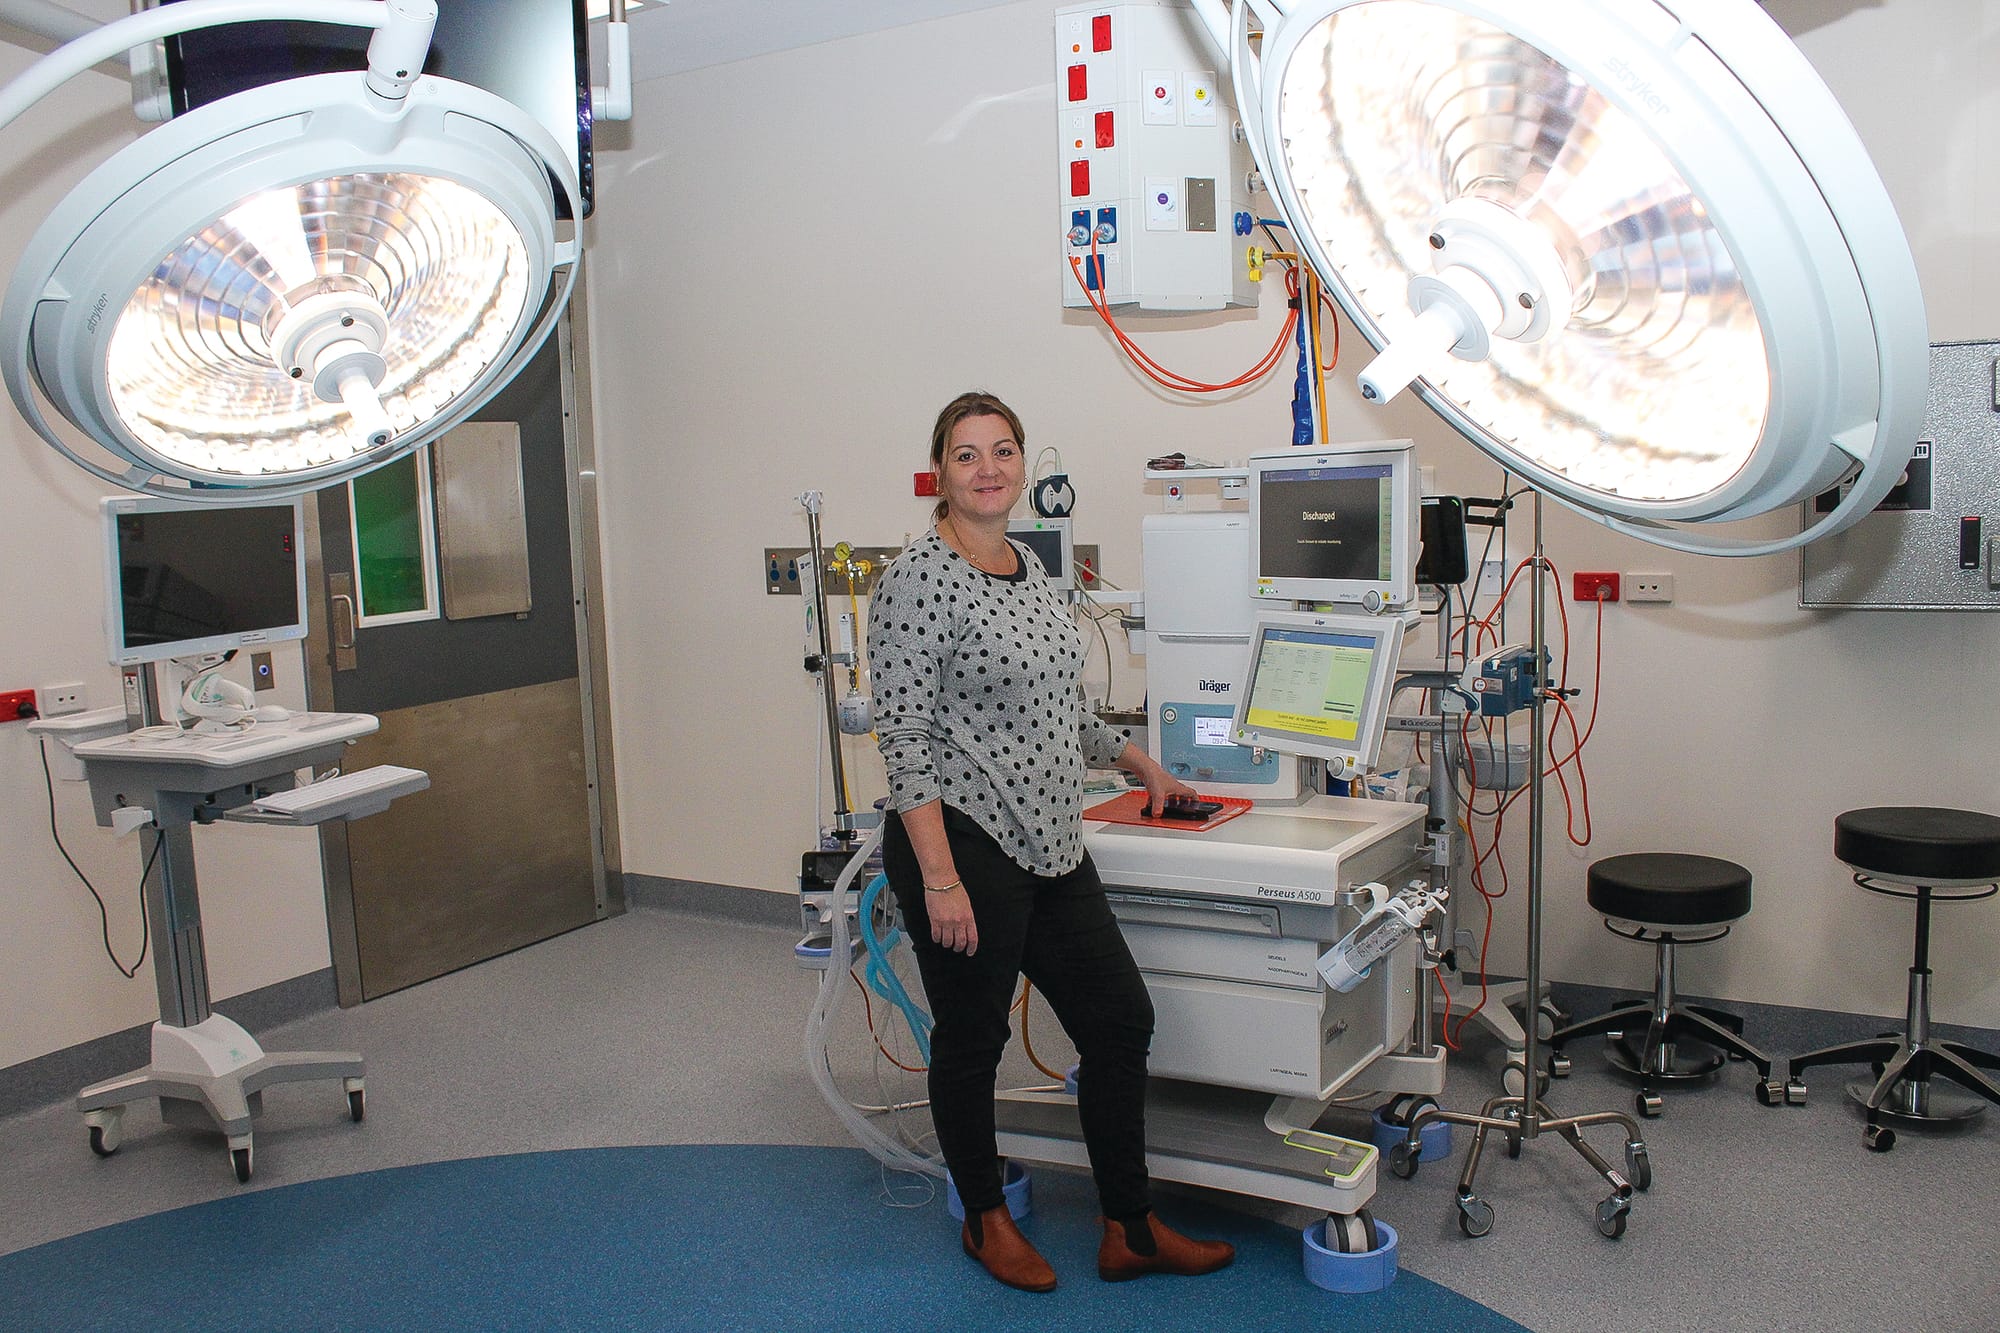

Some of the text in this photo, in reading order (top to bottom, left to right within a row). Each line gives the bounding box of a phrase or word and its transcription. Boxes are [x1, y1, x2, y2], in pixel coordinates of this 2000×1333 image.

[1603, 57, 1671, 115] stryker
[87, 292, 109, 335] stryker
[1302, 511, 1336, 523] Discharged
[1199, 679, 1232, 694] Dräger
[1257, 886, 1322, 902] Perseus A500
